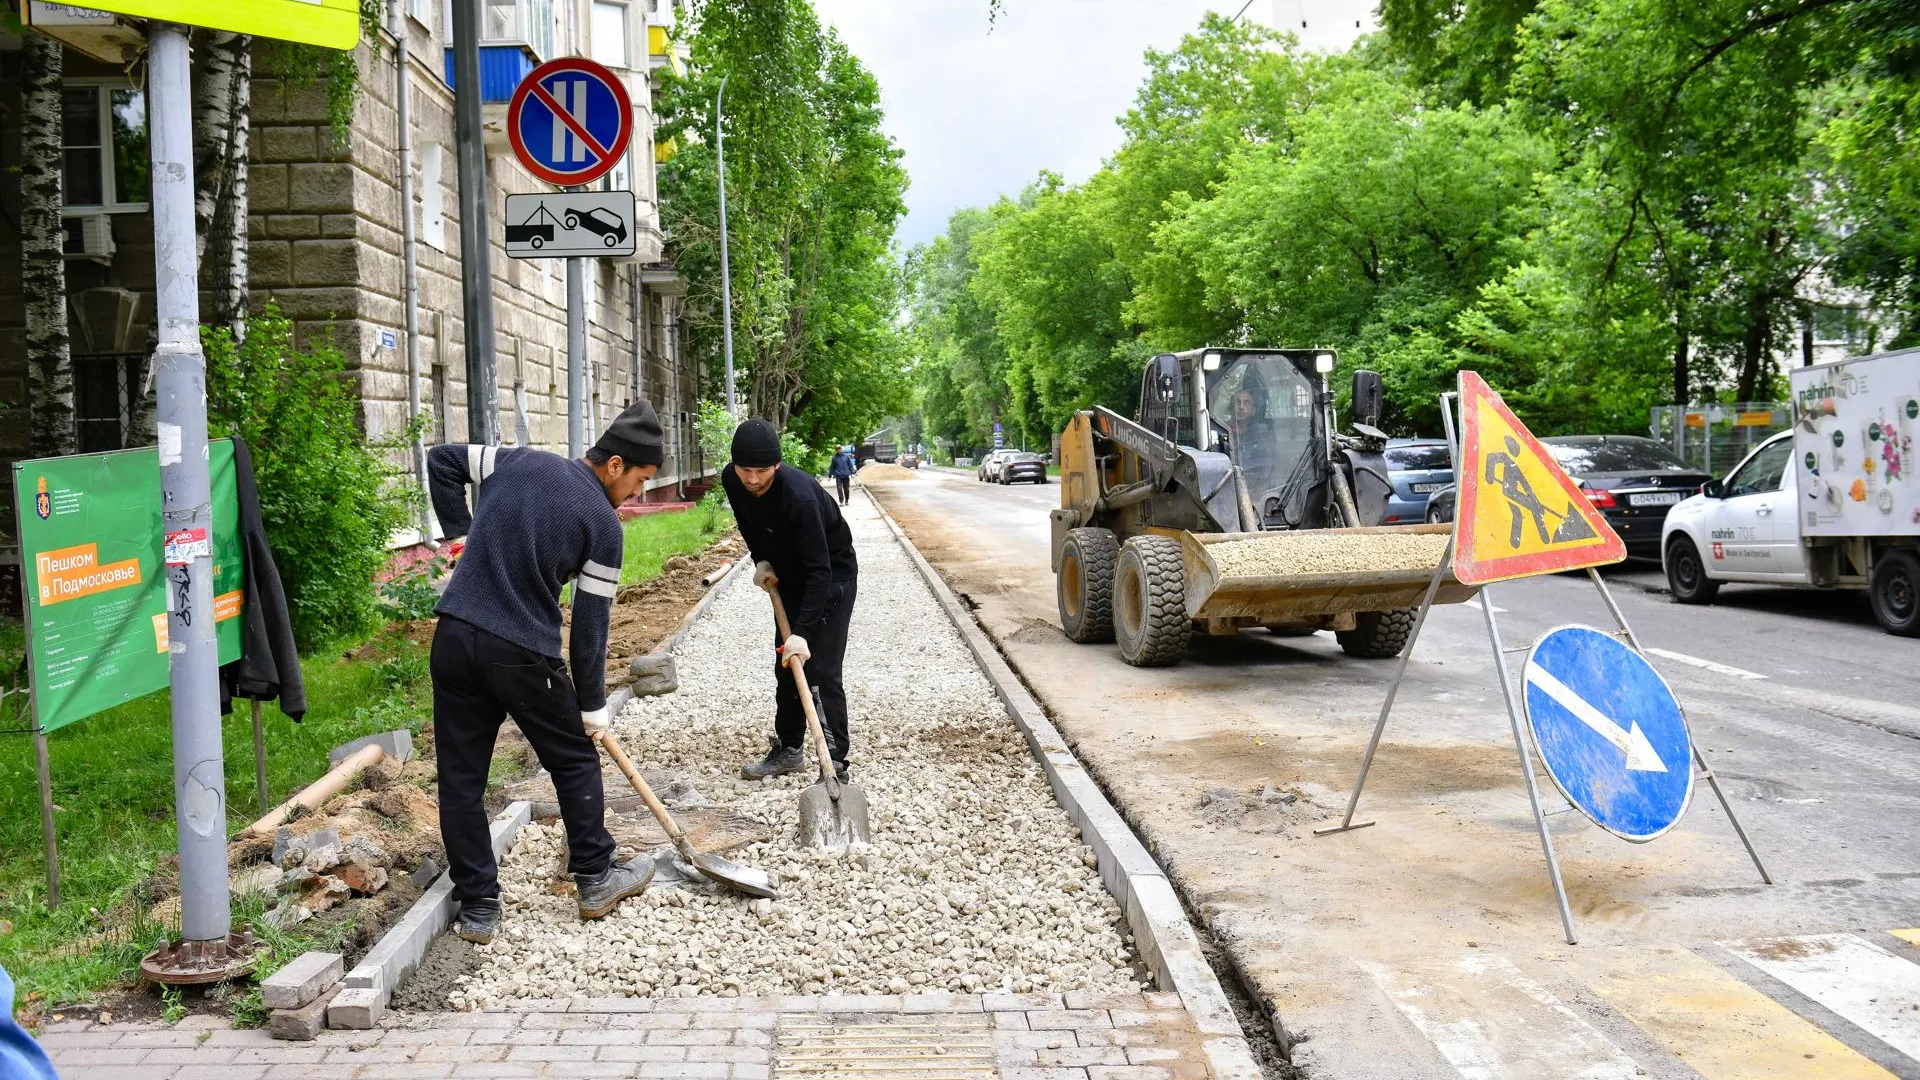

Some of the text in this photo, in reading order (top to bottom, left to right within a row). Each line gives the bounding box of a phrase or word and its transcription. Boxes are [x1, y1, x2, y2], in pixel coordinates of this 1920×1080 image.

[1799, 381, 1835, 400] nahrin
[1711, 527, 1735, 539] nahrin
[40, 552, 93, 574] Пешком
[42, 566, 135, 598] в Подмосковье
